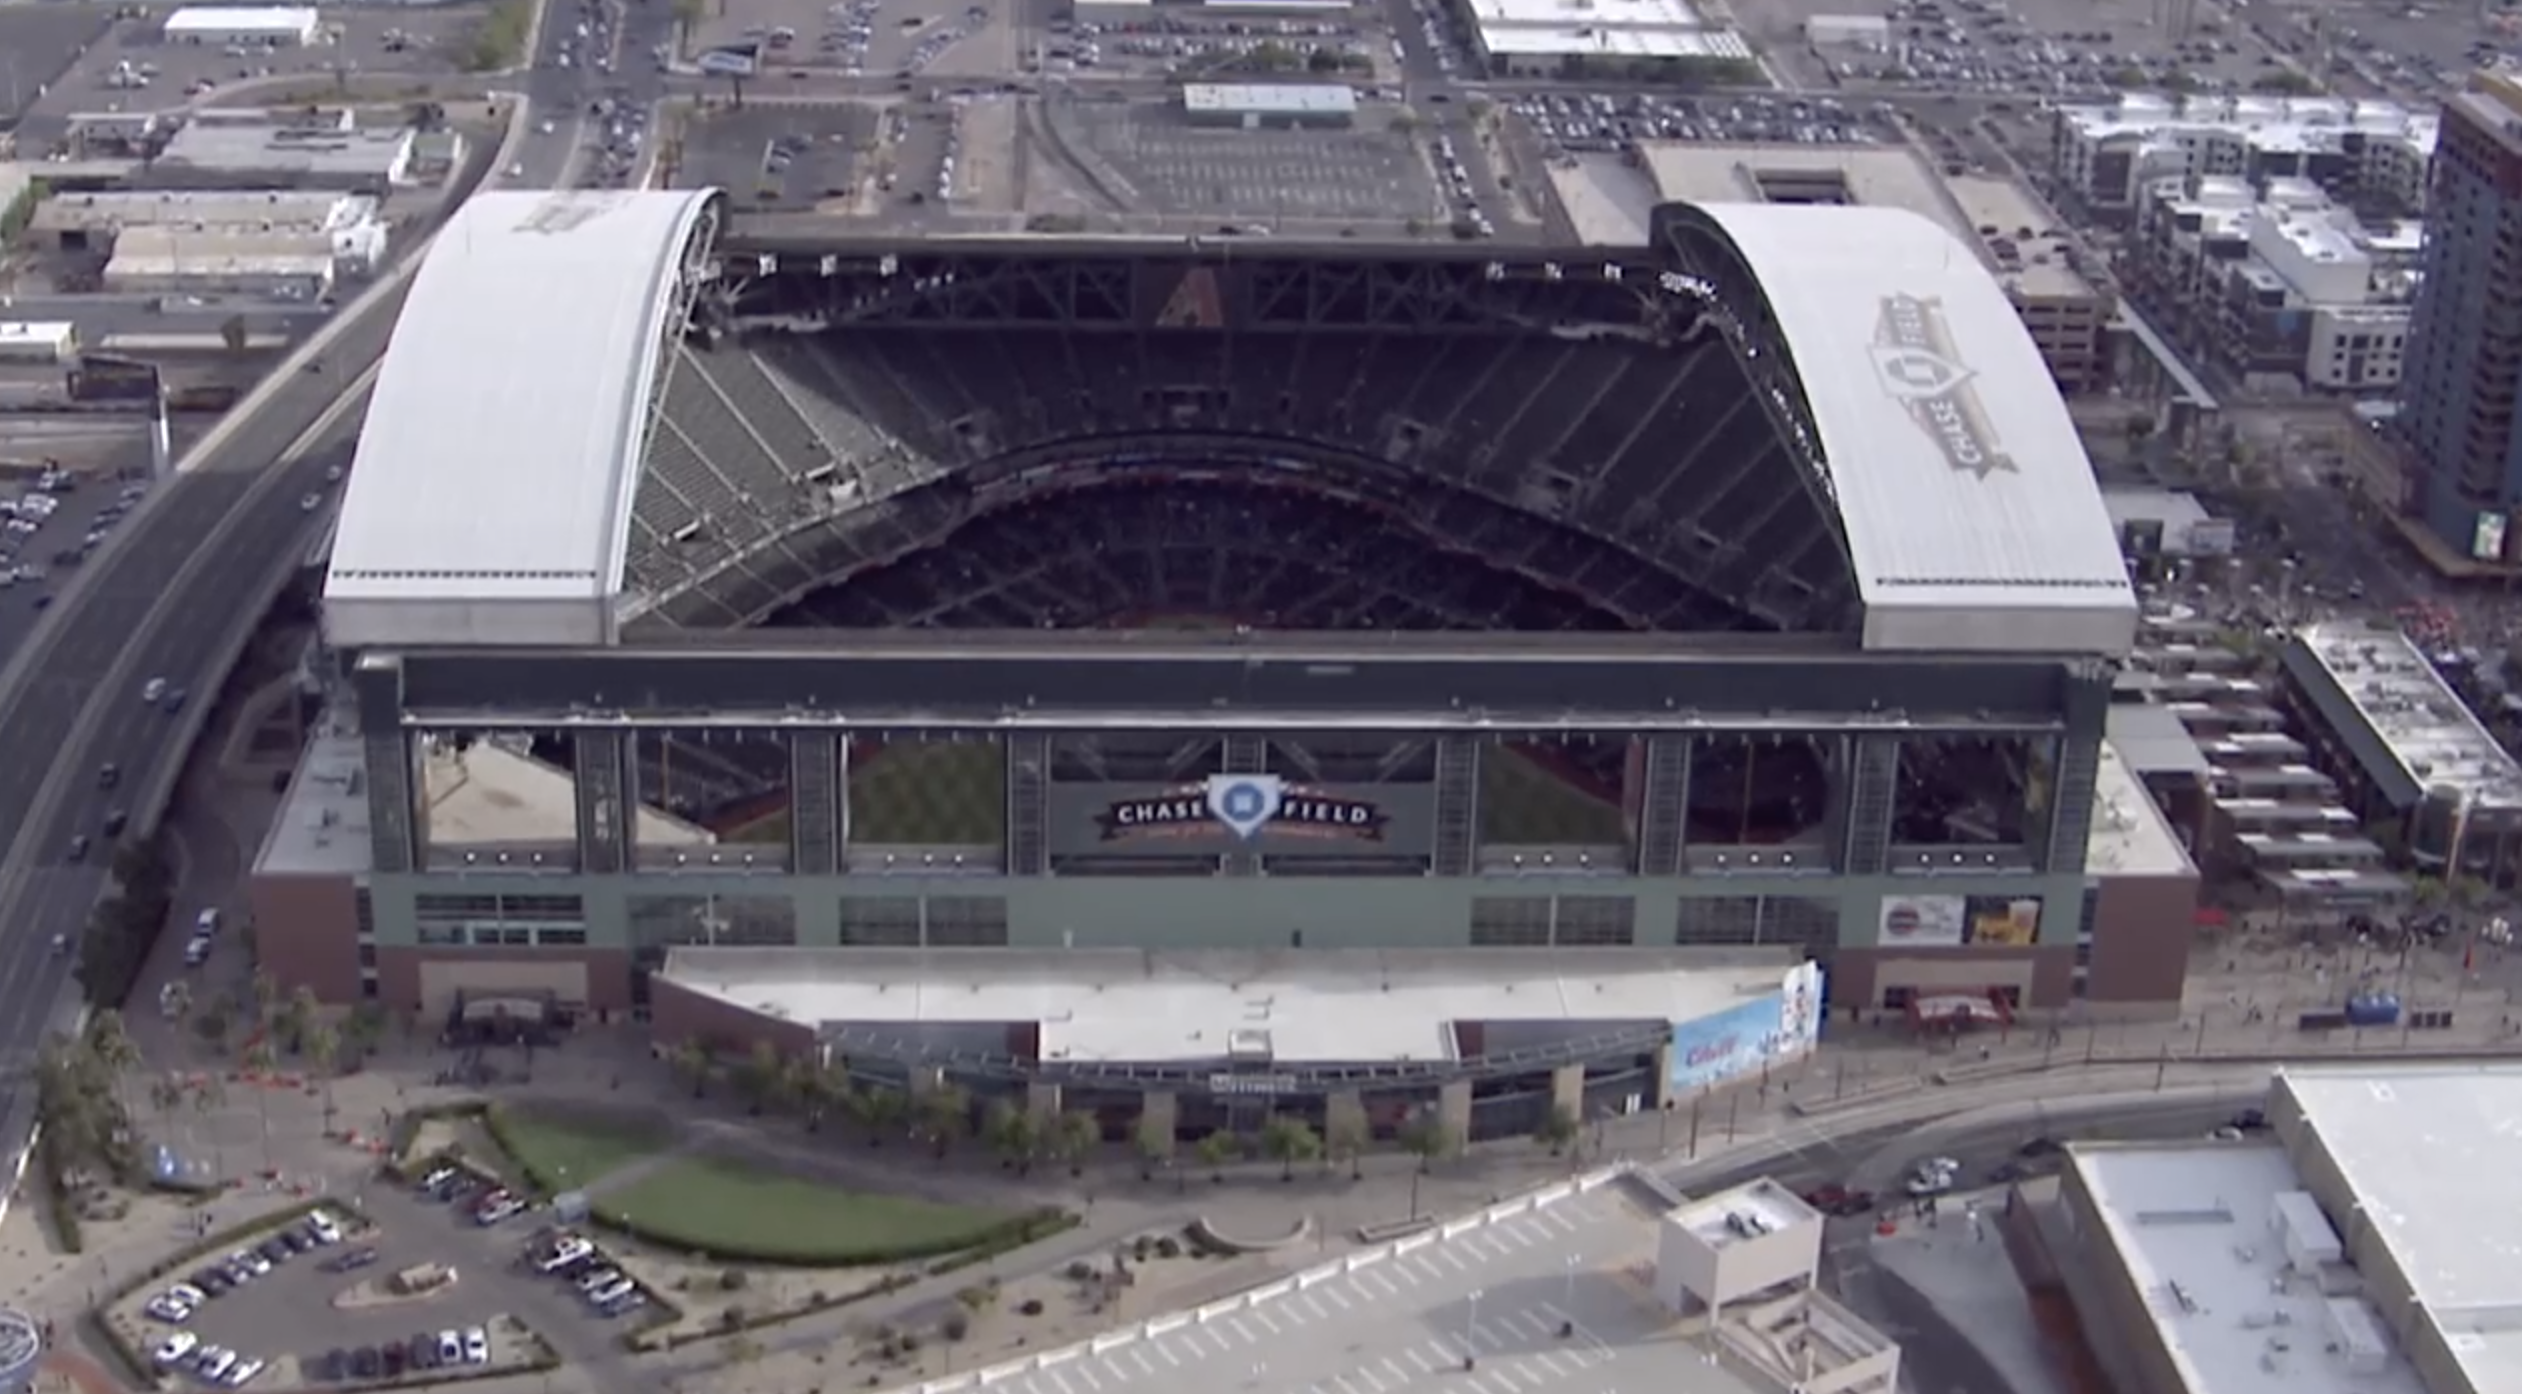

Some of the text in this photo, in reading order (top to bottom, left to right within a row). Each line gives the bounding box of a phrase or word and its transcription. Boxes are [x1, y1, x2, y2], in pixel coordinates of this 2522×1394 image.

[1928, 401, 1982, 464] CHASE
[1118, 800, 1368, 823] CHASE FIELD
